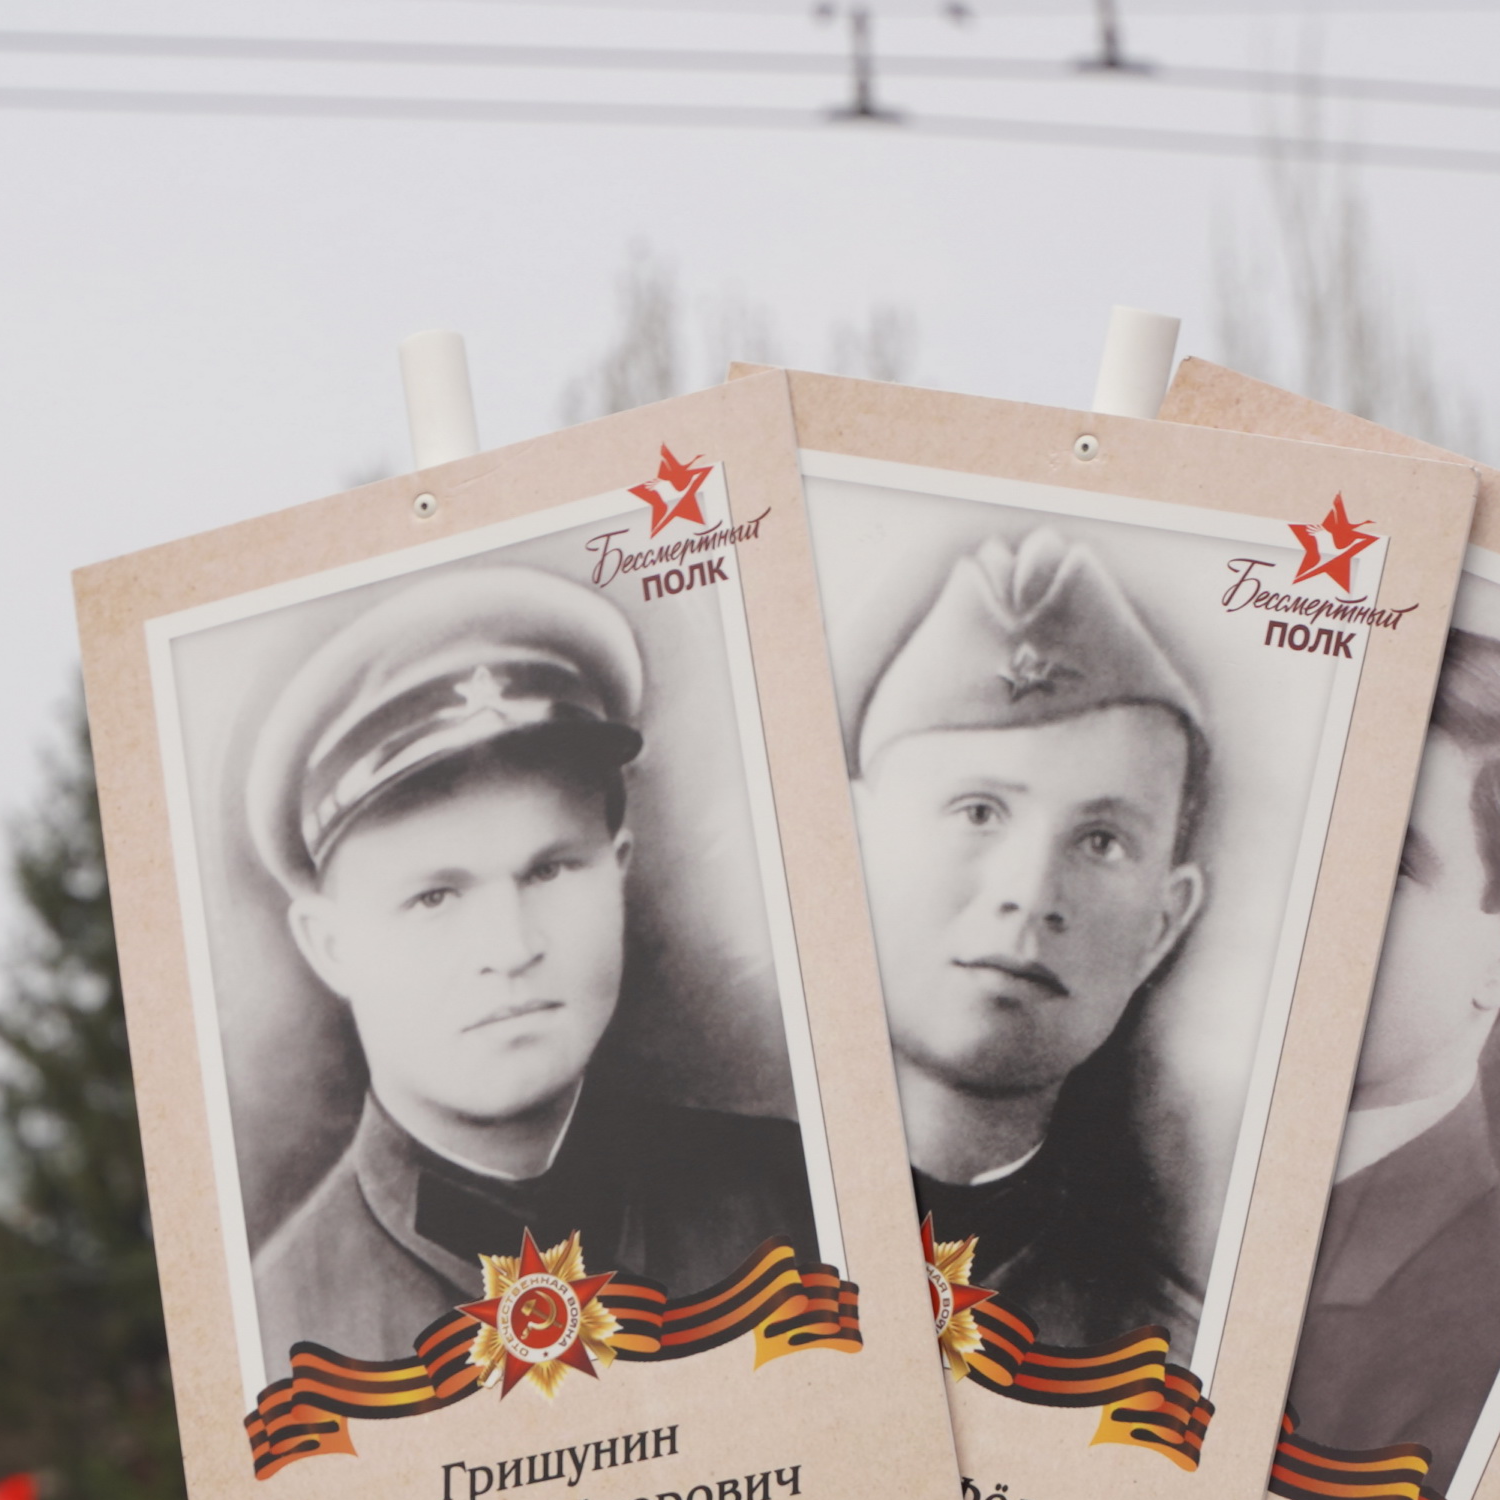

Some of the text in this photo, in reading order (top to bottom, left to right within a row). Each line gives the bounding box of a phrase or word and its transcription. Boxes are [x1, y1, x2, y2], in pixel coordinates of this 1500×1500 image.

[585, 506, 772, 588] Бессмертный
[642, 556, 729, 602] ПОЛК
[1221, 558, 1419, 630] Бессмертный
[1264, 620, 1356, 659] ПОЛК
